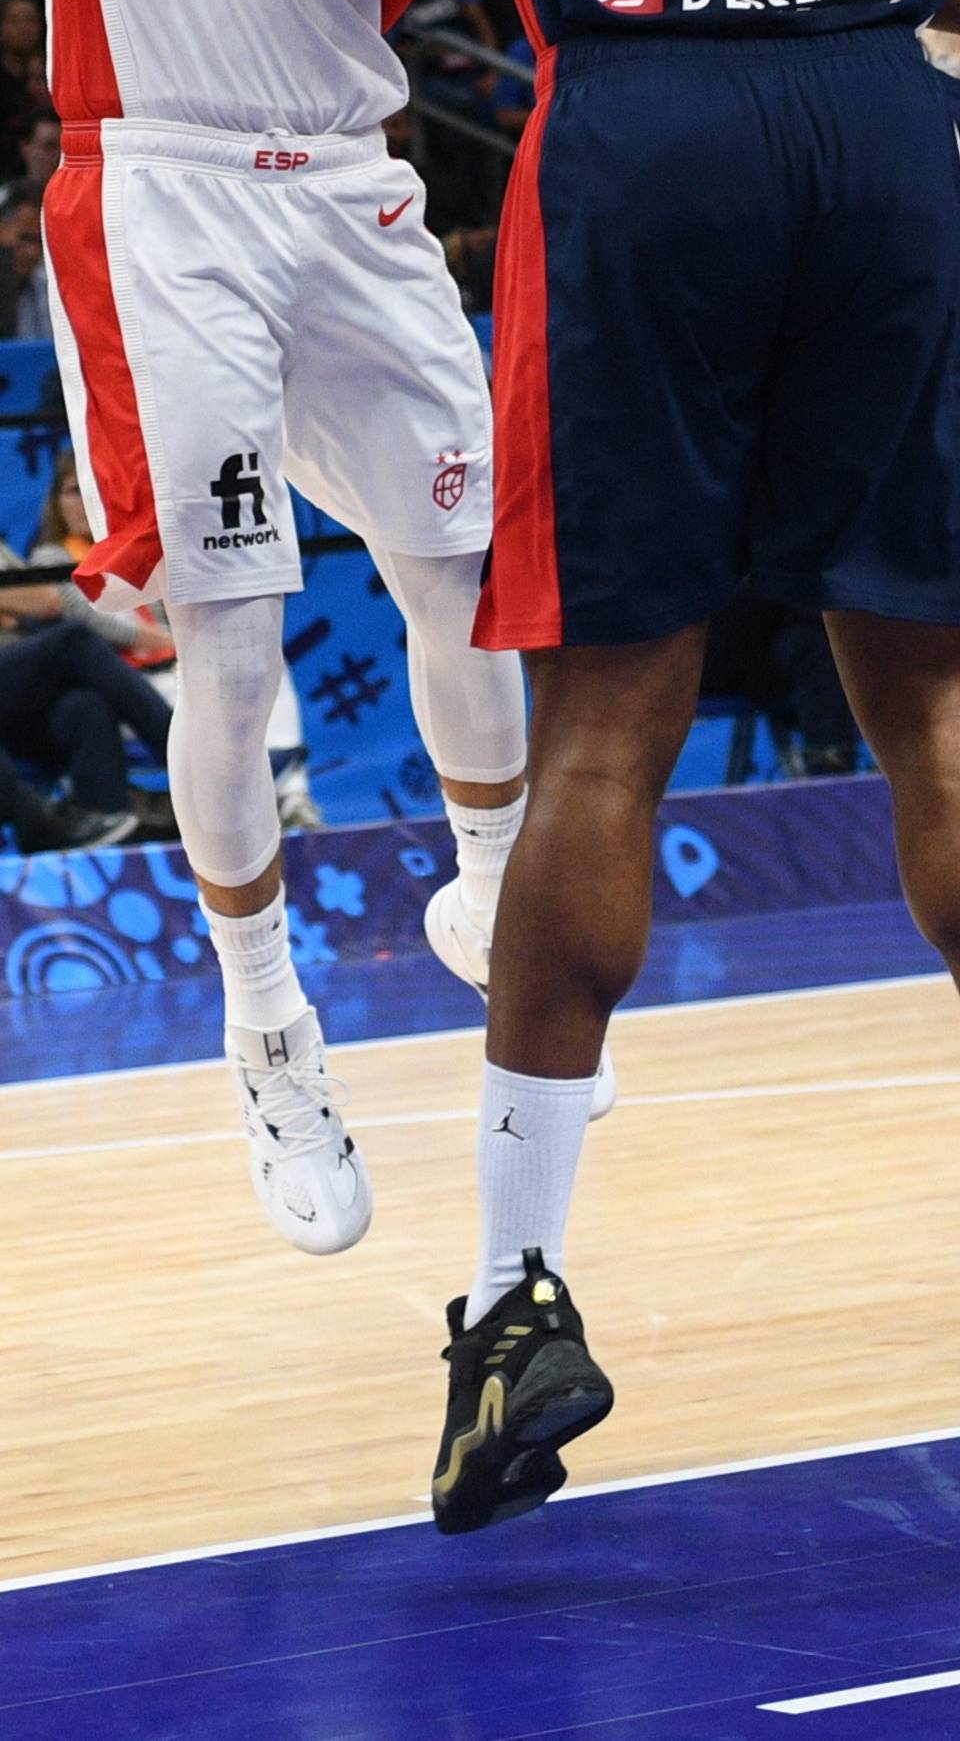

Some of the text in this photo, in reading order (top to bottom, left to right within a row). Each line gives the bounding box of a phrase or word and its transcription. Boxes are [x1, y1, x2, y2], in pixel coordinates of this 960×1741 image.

[254, 149, 310, 171] ESP
[210, 451, 268, 530] fi
[203, 523, 281, 551] network
